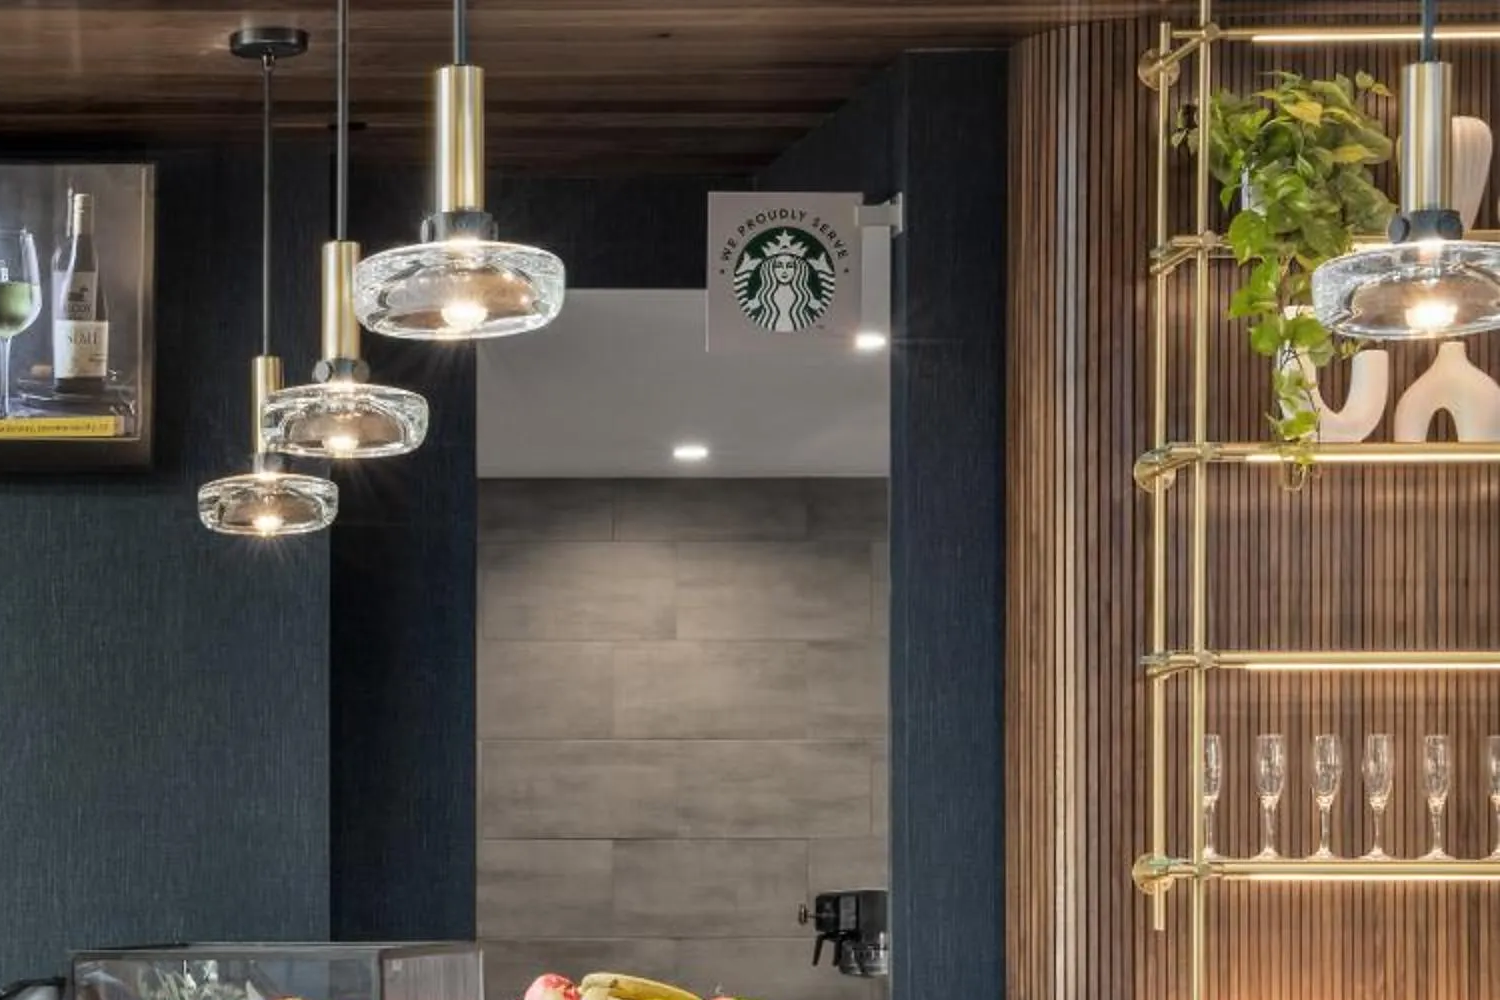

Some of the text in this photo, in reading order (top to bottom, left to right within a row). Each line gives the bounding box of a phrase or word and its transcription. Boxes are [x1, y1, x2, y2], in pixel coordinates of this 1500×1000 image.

[720, 208, 849, 261] WE PROUDLY SERVE
